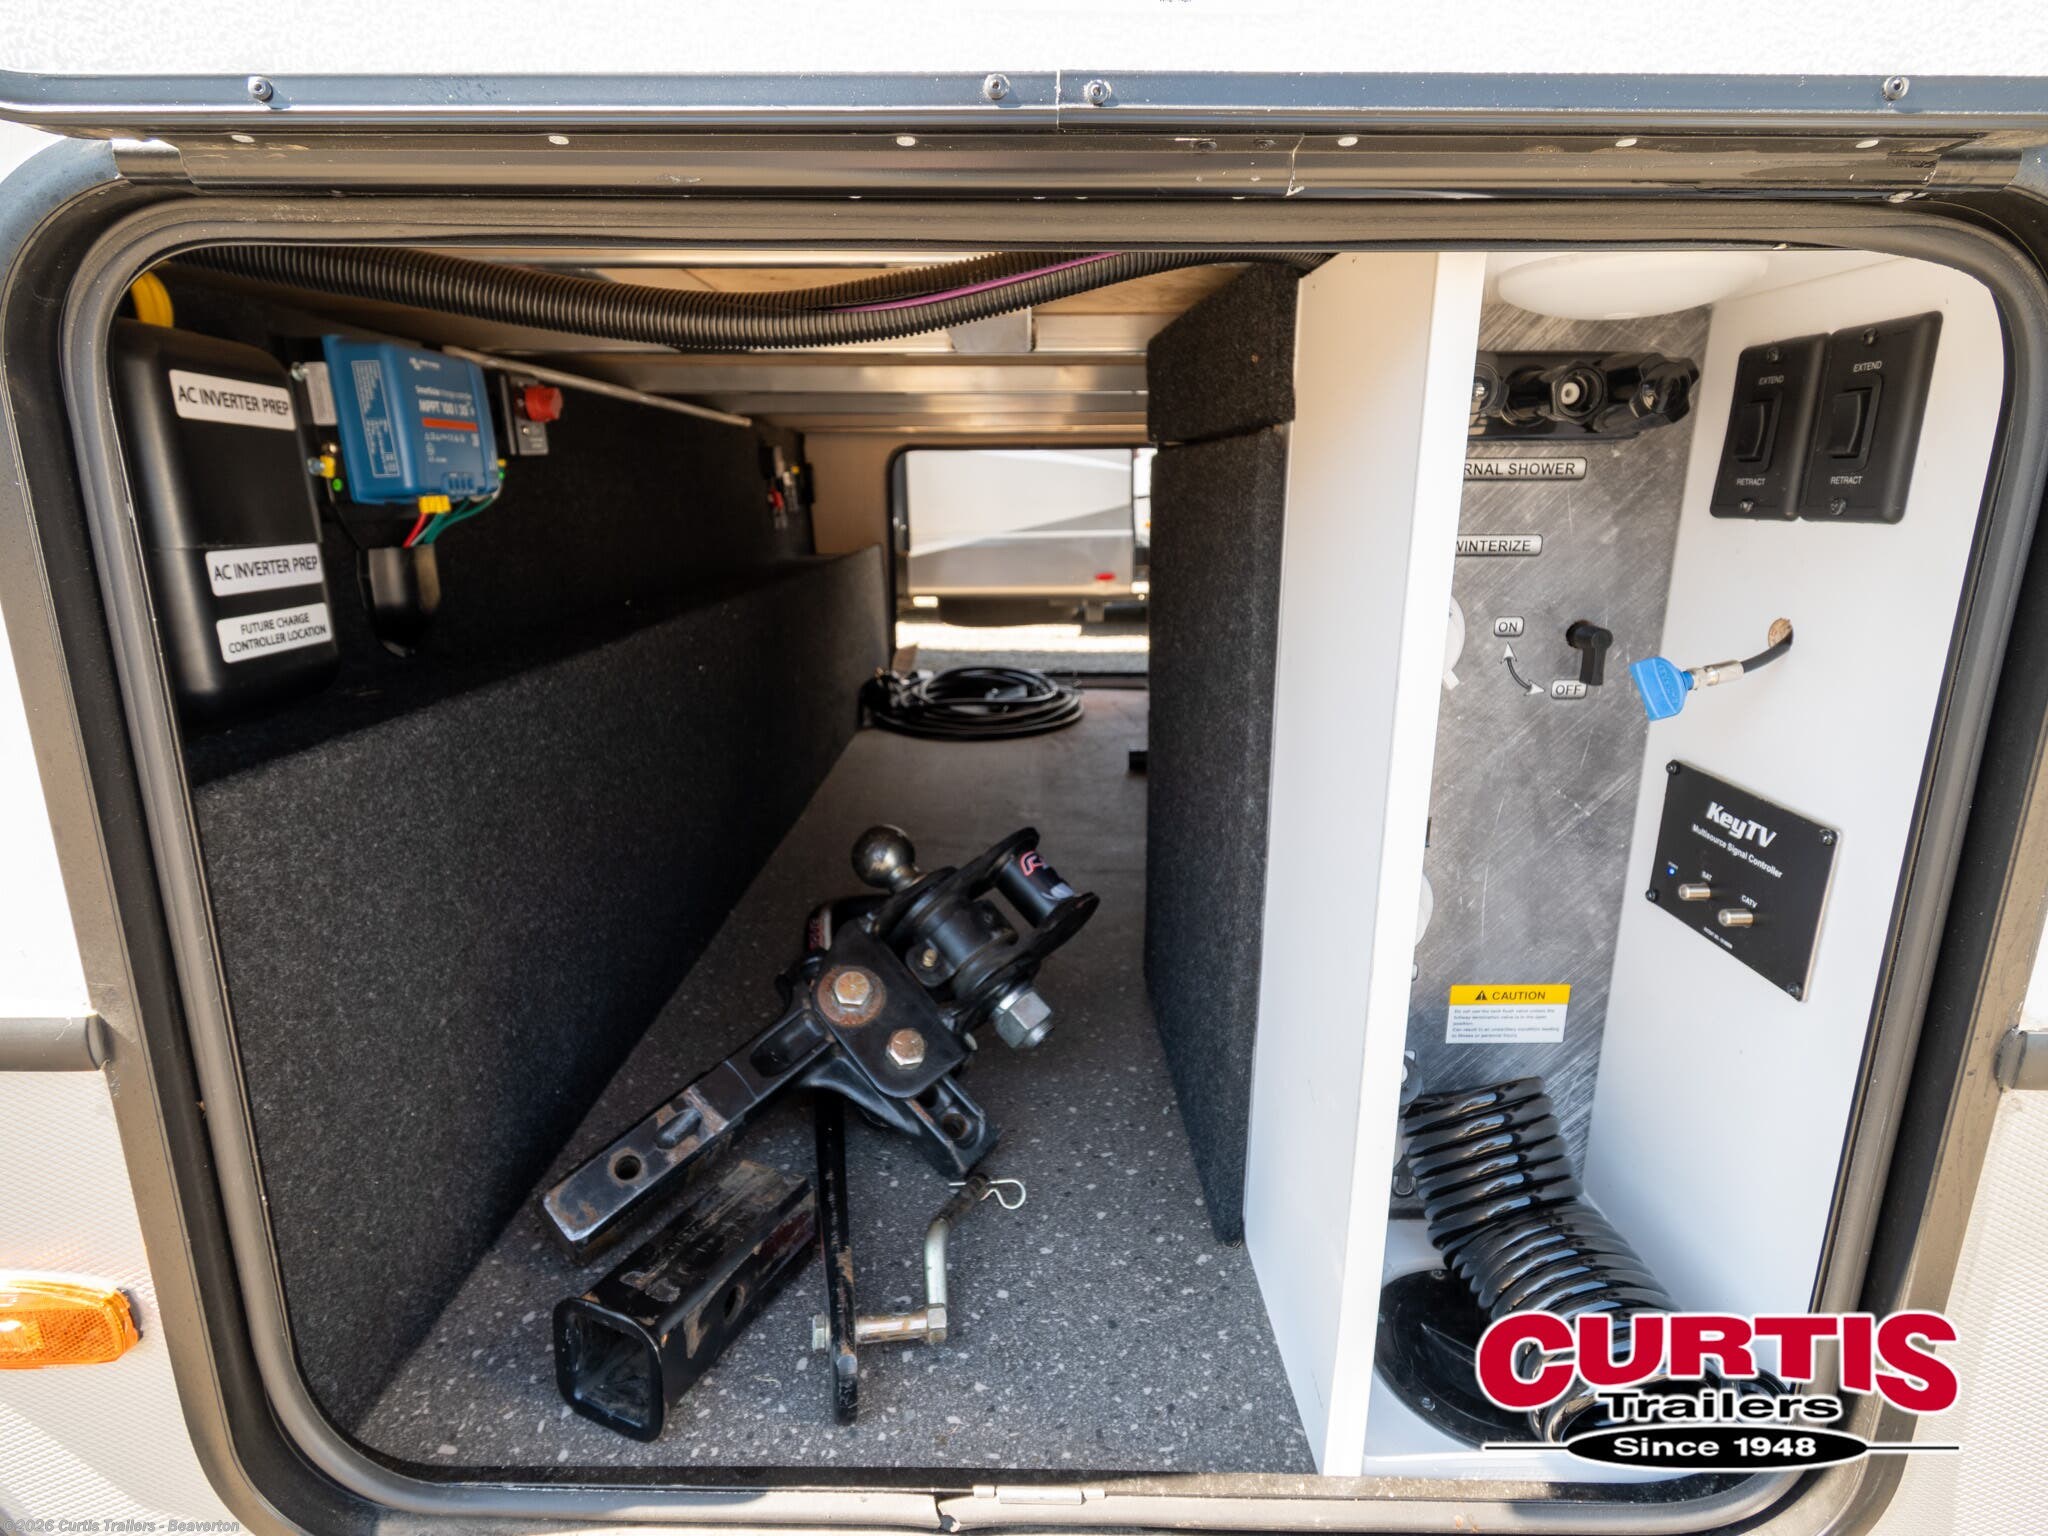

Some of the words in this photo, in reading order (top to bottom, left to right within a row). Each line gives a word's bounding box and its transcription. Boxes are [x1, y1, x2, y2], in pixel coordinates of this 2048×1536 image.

[1853, 360, 1882, 372] EXTEND
[1758, 375, 1785, 386] EXTEND
[178, 384, 198, 404] AC
[199, 388, 259, 412] INVERTER
[263, 397, 289, 416] PREP
[1463, 462, 1503, 476] RNAL
[1508, 462, 1576, 476] SHOWER
[1736, 477, 1766, 486] RETRACT
[1830, 475, 1863, 485] RETRACT
[214, 564, 232, 581] AC
[233, 558, 291, 579] INVERTER
[292, 555, 318, 572] PREP
[240, 618, 275, 635] FUTURE
[276, 612, 310, 628] CHARGE
[1498, 621, 1518, 633] ON
[228, 633, 286, 654] CONTROLLER
[287, 624, 327, 641] LOCATION
[1555, 684, 1582, 696] OFF
[1706, 801, 1777, 848] KeyTV
[1691, 823, 1727, 849] Multisource
[1727, 842, 1748, 860] Signal
[1748, 852, 1783, 879] Controller
[1701, 870, 1713, 882] SAT
[1740, 894, 1758, 909] CATV
[1491, 991, 1547, 1000] CAUTION
